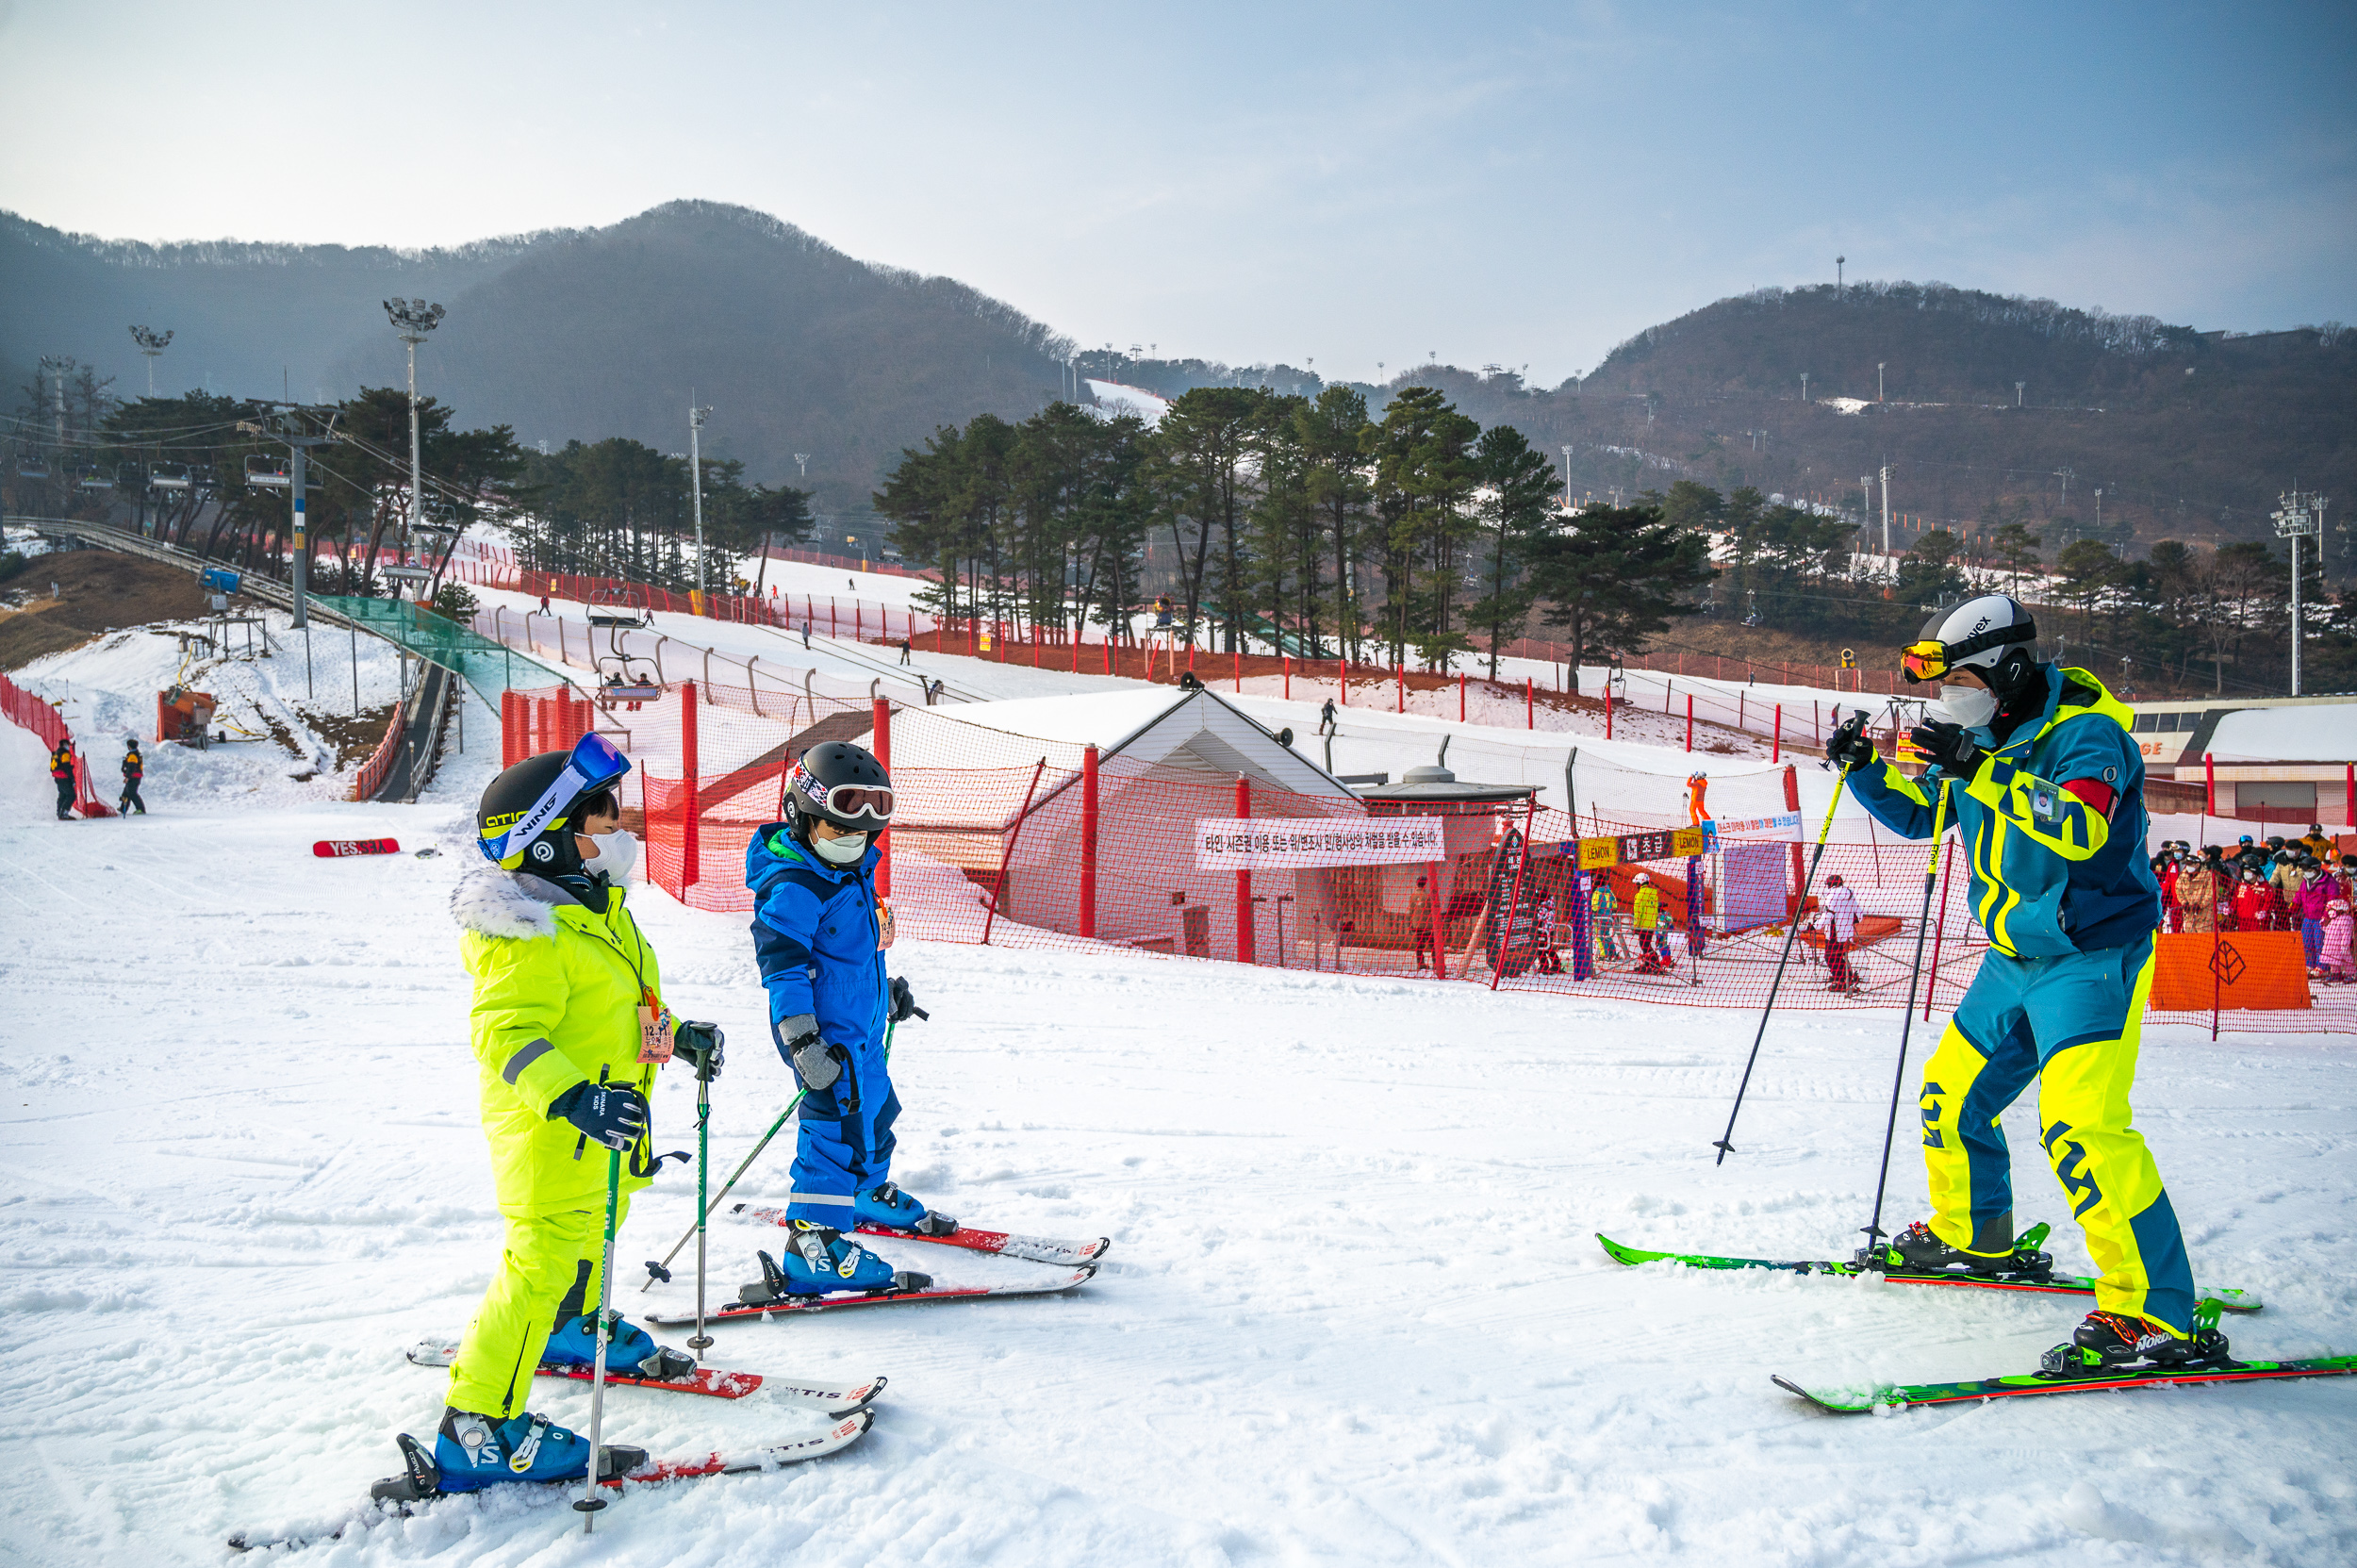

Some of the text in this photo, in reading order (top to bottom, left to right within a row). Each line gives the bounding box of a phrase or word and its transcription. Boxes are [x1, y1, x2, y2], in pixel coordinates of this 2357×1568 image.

[514, 792, 557, 836] WING
[1206, 834, 1223, 853] 타인
[1227, 834, 1252, 853] 시즌권
[1254, 834, 1270, 853] 이용
[1273, 834, 1288, 851] 또는
[1365, 832, 1385, 849] 처벌을
[1387, 832, 1401, 848] 받을
[1402, 832, 1409, 848] 수
[1641, 835, 1663, 853] 초급
[1679, 836, 1699, 850] LEMON
[1587, 847, 1609, 860] LEMON
[599, 1091, 607, 1116] SKINARA
[839, 1420, 858, 1436] 100
